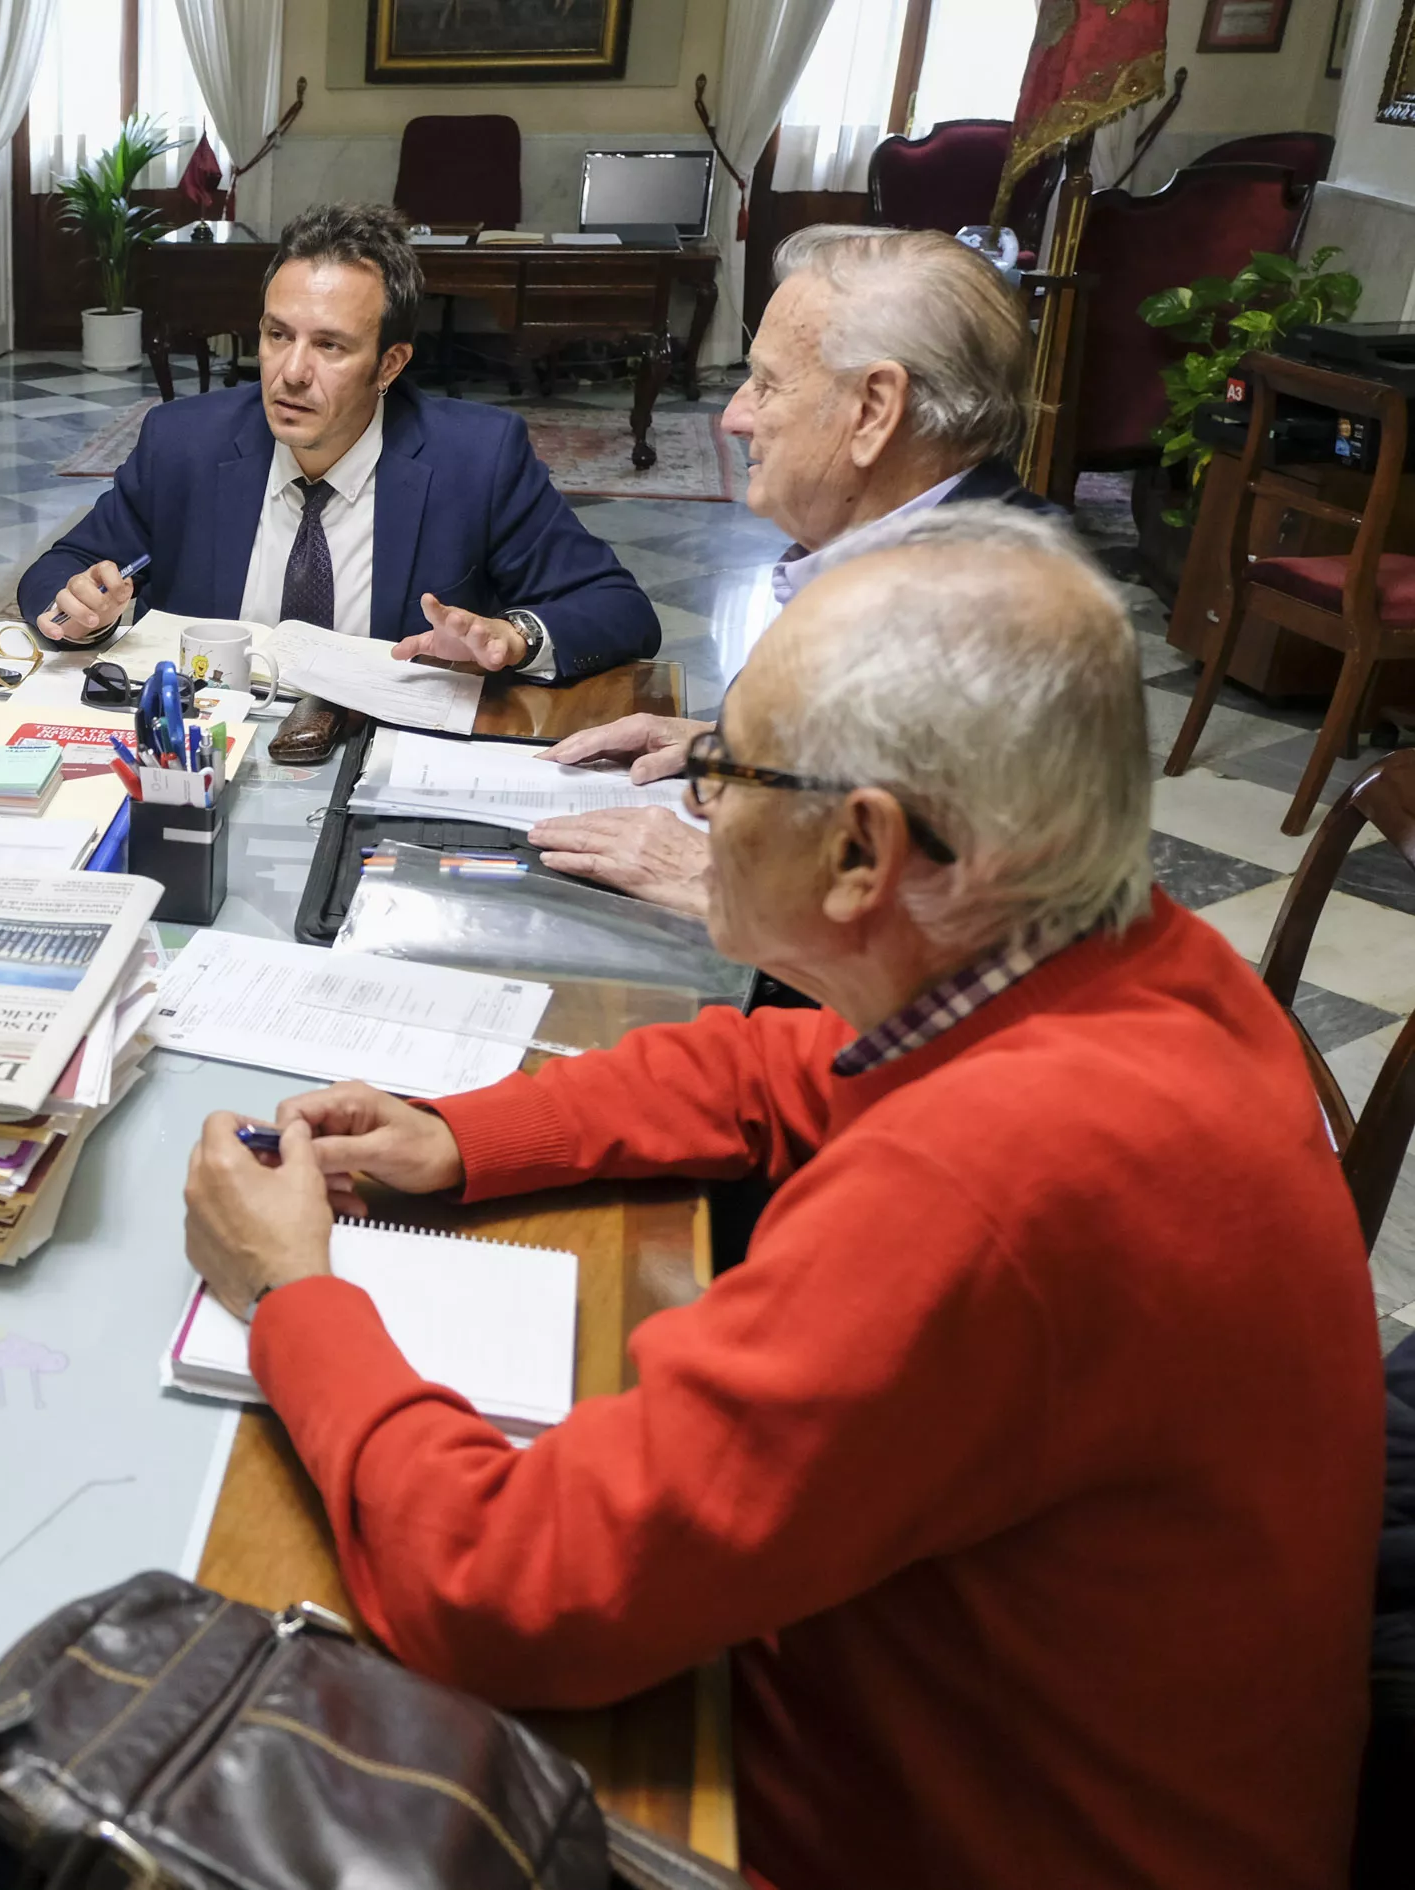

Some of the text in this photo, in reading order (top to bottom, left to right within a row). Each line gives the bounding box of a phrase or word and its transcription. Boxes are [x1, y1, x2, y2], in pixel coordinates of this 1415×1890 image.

[1226, 383, 1243, 402] A3
[58, 734, 122, 744] DIGNIDA
[74, 928, 104, 939] Los
[35, 1010, 58, 1021] al
[26, 1022, 50, 1033] El
